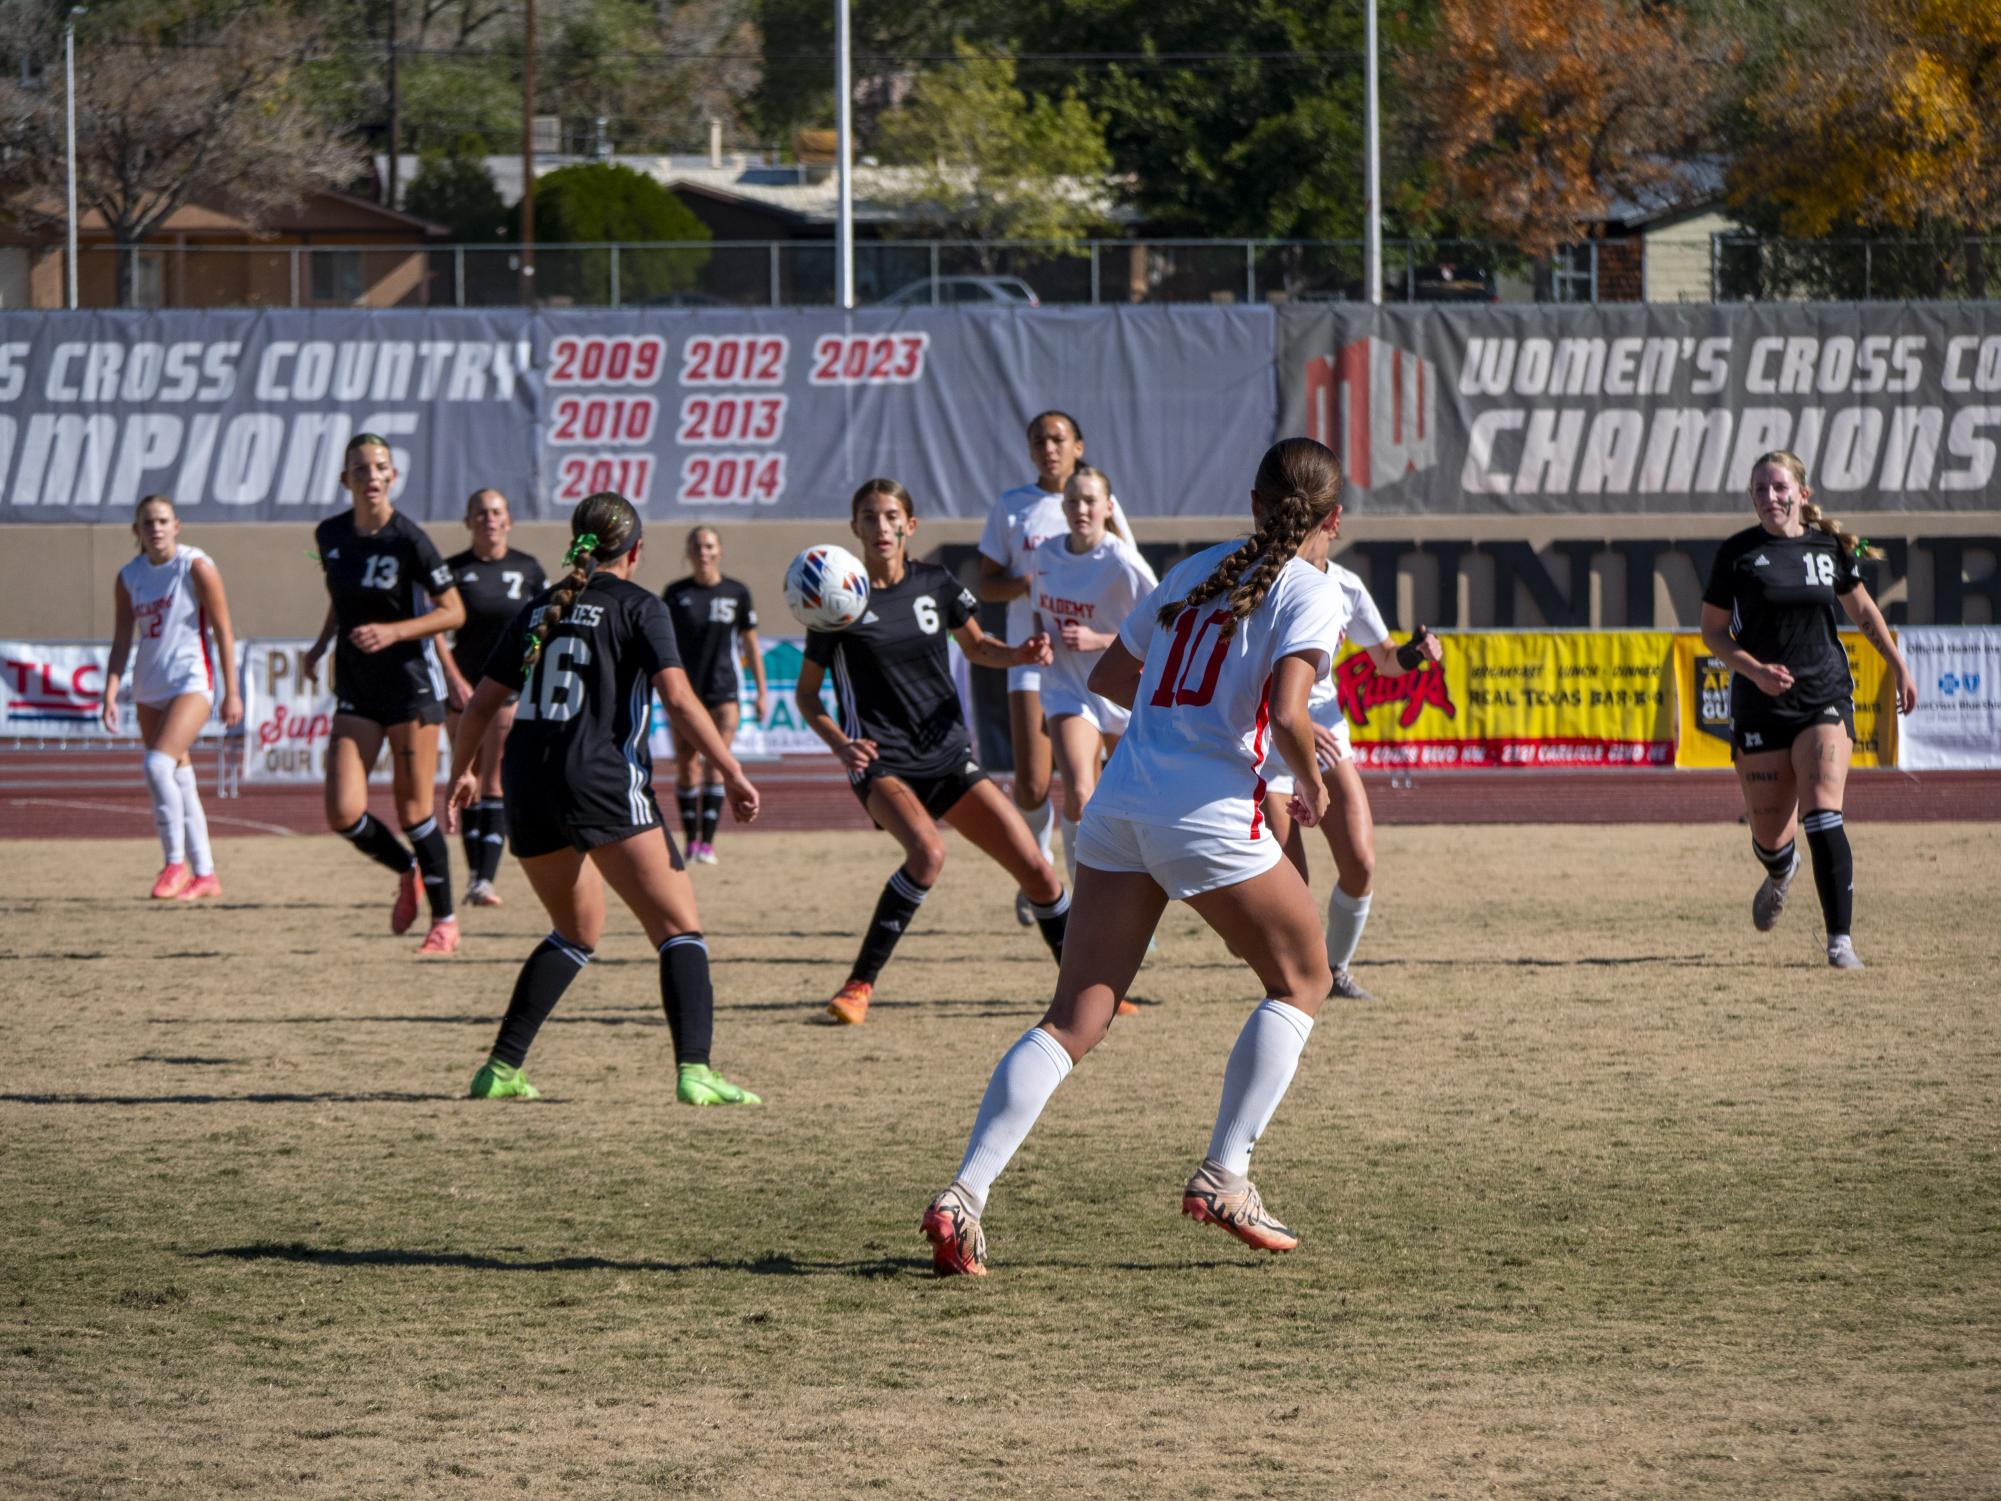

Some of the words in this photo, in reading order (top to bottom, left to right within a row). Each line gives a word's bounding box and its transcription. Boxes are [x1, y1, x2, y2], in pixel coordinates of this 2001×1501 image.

[45, 342, 242, 401] CROSS
[255, 341, 531, 401] COUNTRY
[549, 338, 663, 383] 2009
[682, 338, 786, 383] 2012
[812, 336, 926, 383] 2023
[1459, 337, 1732, 395] WOMEN'S
[1745, 336, 1927, 394] CROSS
[552, 398, 654, 443] 2010
[680, 398, 784, 443] 2013
[1461, 406, 2001, 494] CHAMPIONS
[558, 457, 651, 502] 2011
[680, 457, 782, 502] 2014
[361, 554, 399, 590] 13
[502, 571, 524, 600] 7
[1802, 552, 1836, 586] 18
[709, 597, 738, 624] 15
[913, 595, 940, 635] 6
[1150, 608, 1233, 708] 10
[1557, 665, 1599, 678] LUNCH
[6, 660, 99, 699] TLC
[514, 636, 593, 721] 16
[1469, 690, 1516, 706] REAL
[1523, 690, 1581, 706] TEXAS
[266, 749, 313, 772] OUR
